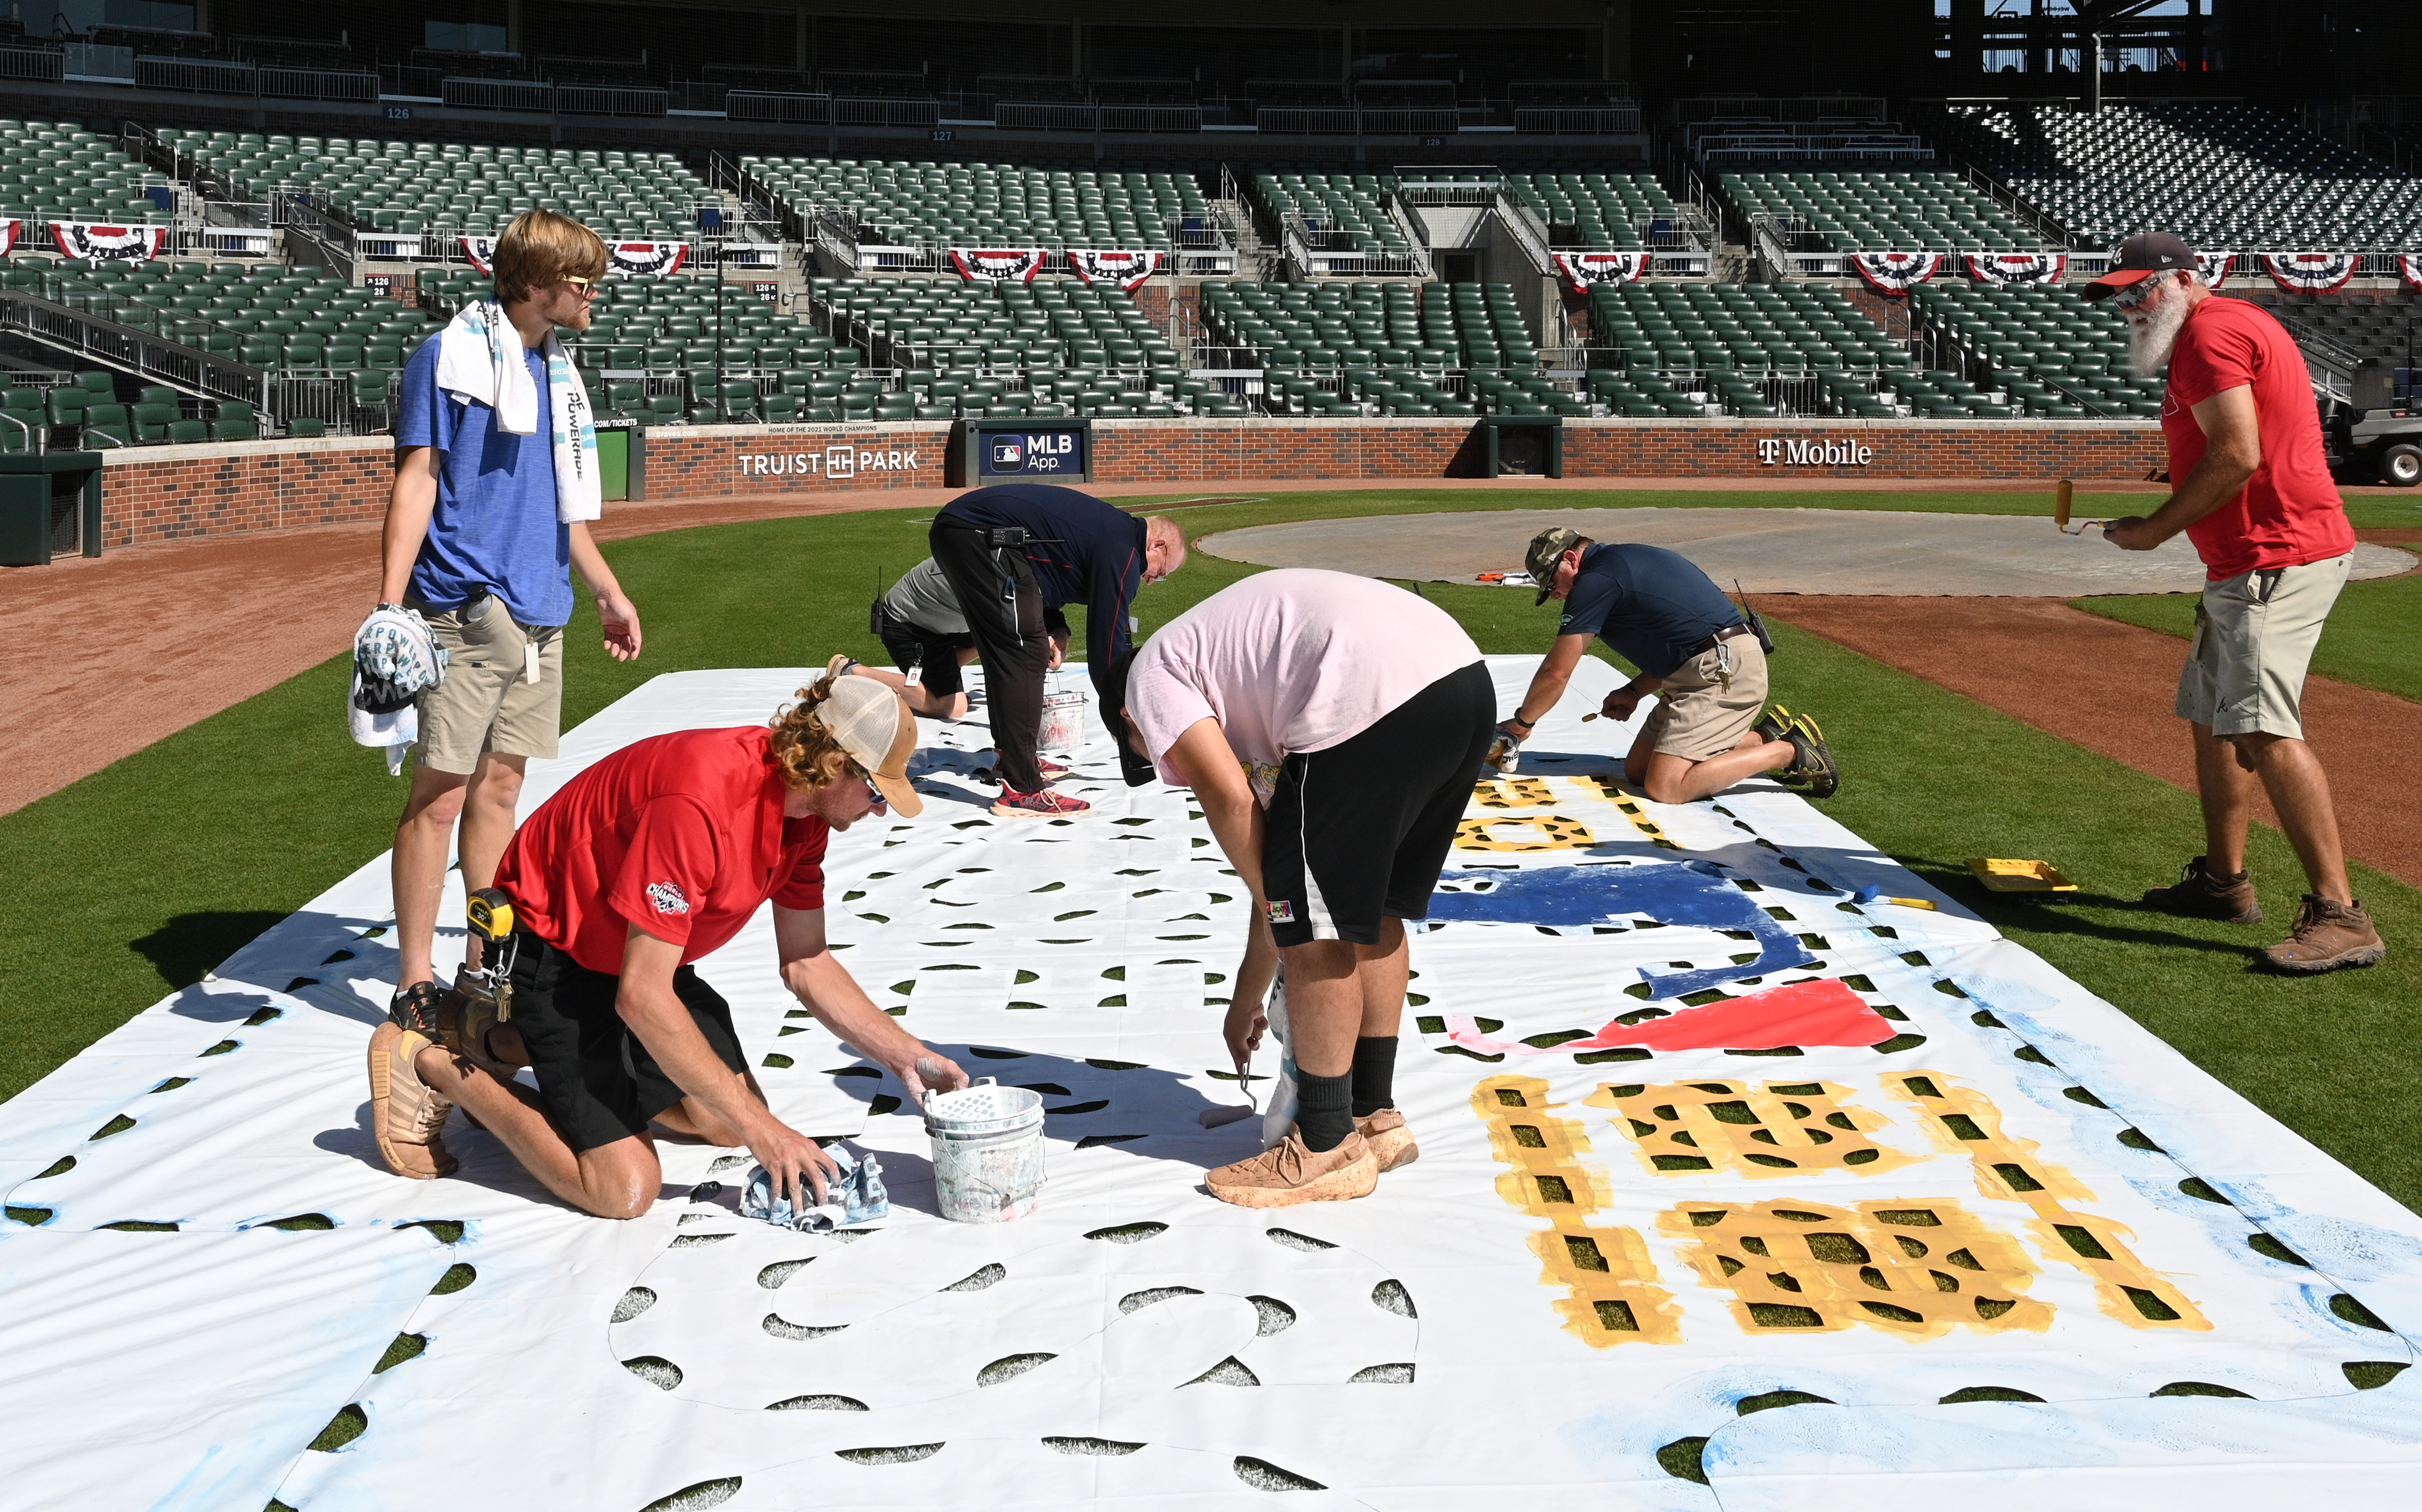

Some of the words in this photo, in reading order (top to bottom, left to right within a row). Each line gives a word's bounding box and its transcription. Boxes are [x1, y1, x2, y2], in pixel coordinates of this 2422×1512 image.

[388, 108, 409, 119] 126
[933, 131, 952, 140] 127
[374, 277, 389, 286] 126
[374, 287, 385, 296] 26
[1027, 434, 1072, 455] MLB
[738, 453, 821, 476] TRUIST
[860, 450, 918, 471] PARK
[663, 883, 683, 899] WORLD
[647, 883, 689, 914] CHAMPIONS
